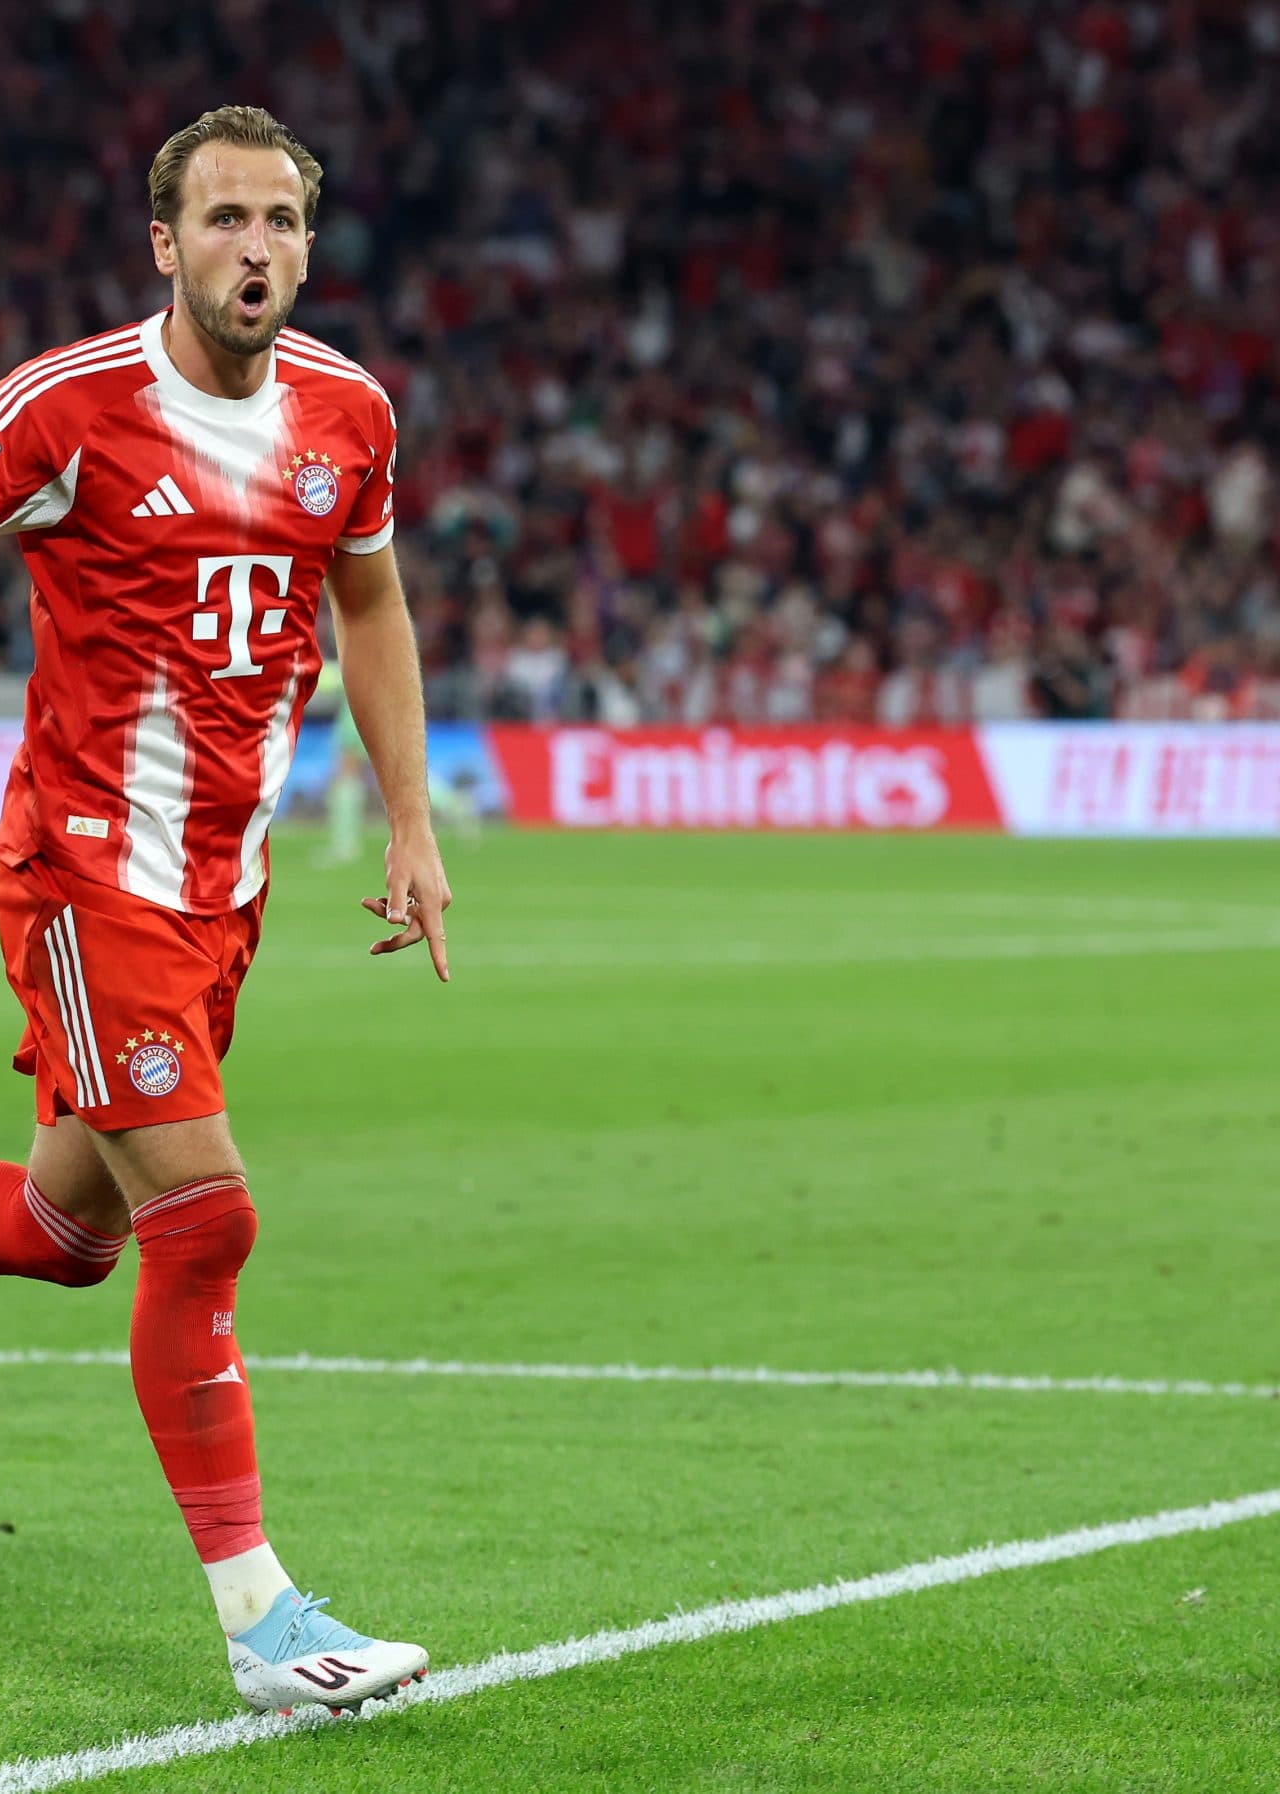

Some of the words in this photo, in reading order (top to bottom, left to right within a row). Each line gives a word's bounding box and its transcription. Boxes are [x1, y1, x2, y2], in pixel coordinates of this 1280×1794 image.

[305, 468, 334, 487] BAYERN
[548, 728, 951, 827] Emirates
[133, 1058, 142, 1071] FC
[140, 1048, 175, 1065] BAYERN
[212, 1311, 232, 1320] MIA
[211, 1327, 232, 1337] MIA
